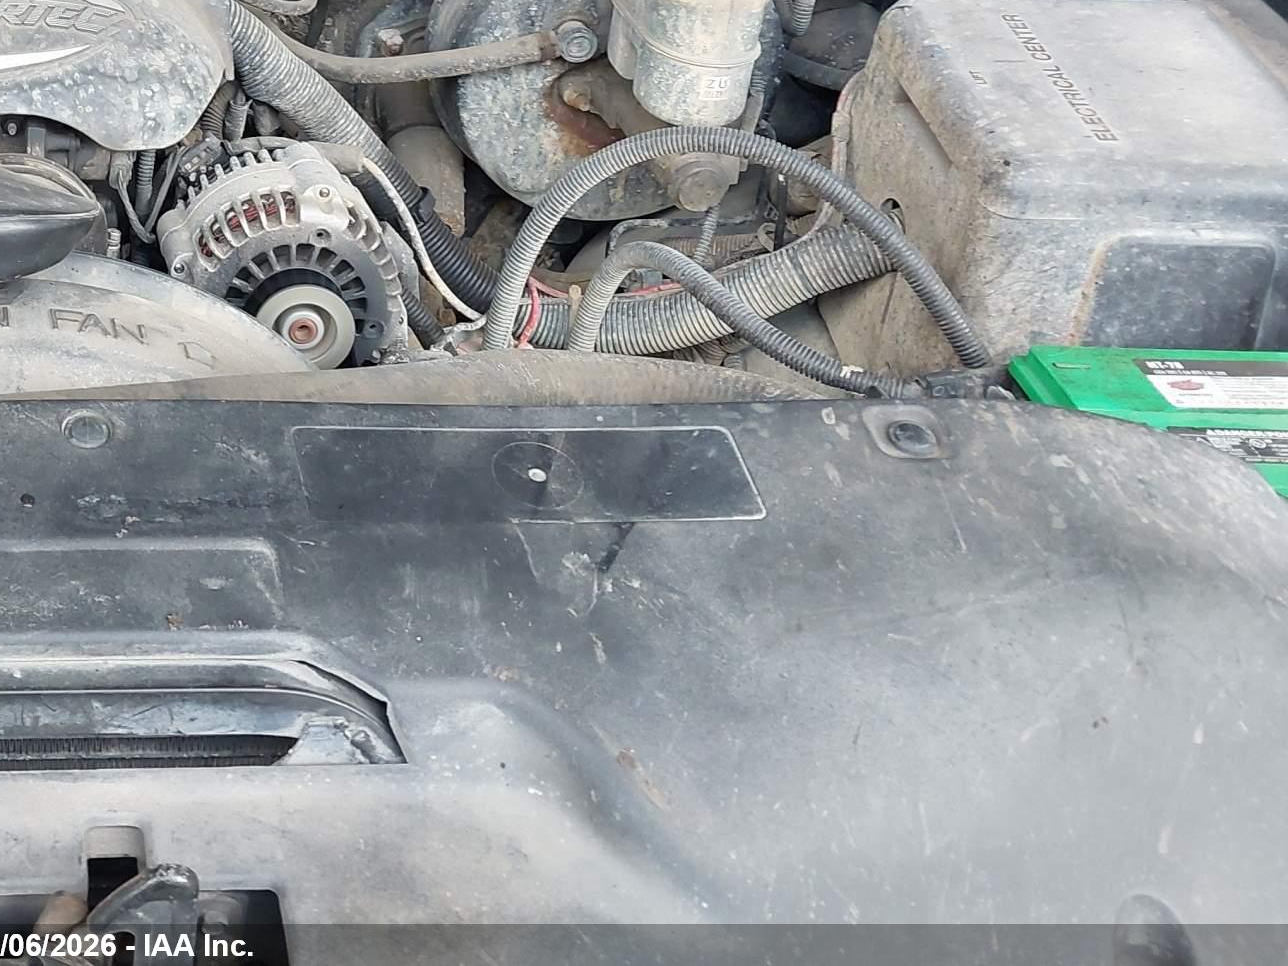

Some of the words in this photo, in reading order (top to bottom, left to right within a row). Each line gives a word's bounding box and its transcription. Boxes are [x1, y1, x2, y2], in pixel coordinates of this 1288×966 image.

[1001, 14, 1052, 62] CENTER
[968, 70, 988, 85] LIFT
[49, 308, 147, 345] FAN
